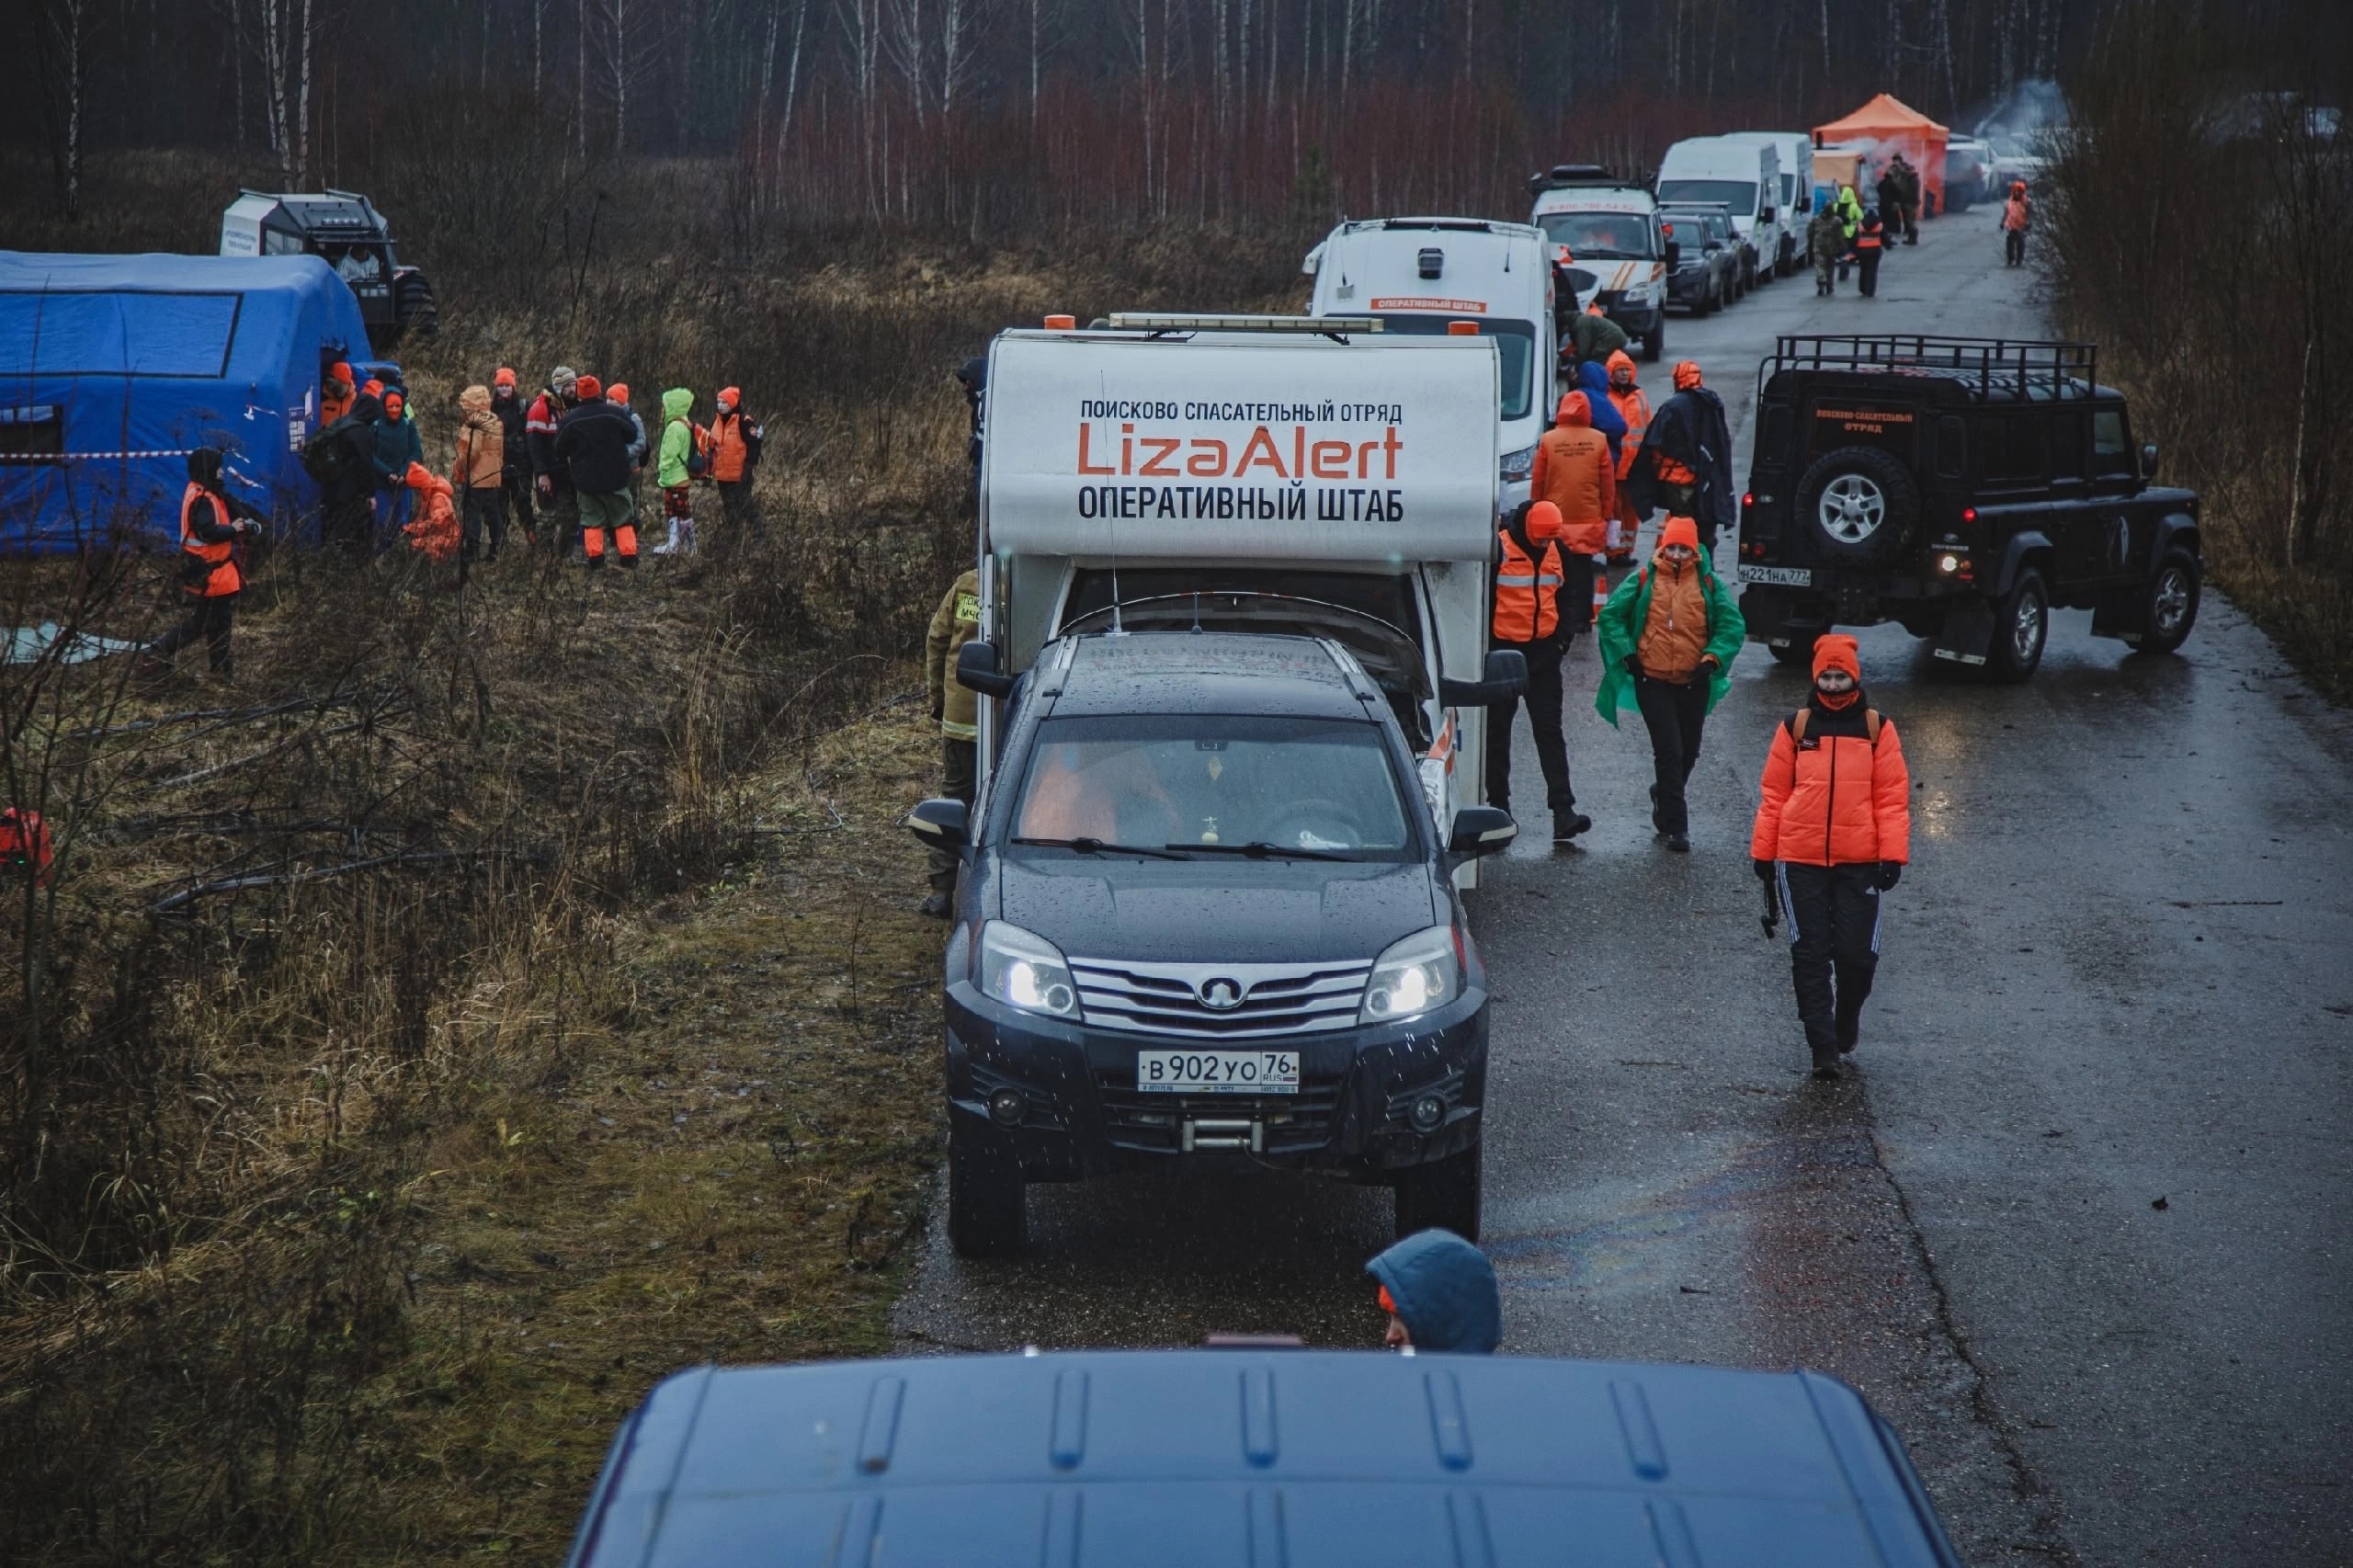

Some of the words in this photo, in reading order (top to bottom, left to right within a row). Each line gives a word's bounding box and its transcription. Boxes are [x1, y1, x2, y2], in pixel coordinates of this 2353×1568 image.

[1378, 299, 1451, 310] ОПЕРАТИВНЫЙ
[1452, 301, 1482, 312] ШТАБ
[1080, 399, 1179, 420] ПОИСКОВО
[1185, 399, 1335, 423] СПАСАТЕЛЬНЫЙ
[1340, 403, 1403, 426] ОТРЯД
[1844, 422, 1882, 434] ОТРЯД
[1077, 422, 1404, 480] LizaAlert
[1078, 480, 1306, 521] ОПЕРАТИВНЫЙ
[1317, 489, 1404, 523] ШТАБ
[1265, 1054, 1290, 1074] 76
[1263, 1074, 1282, 1082] RUS
